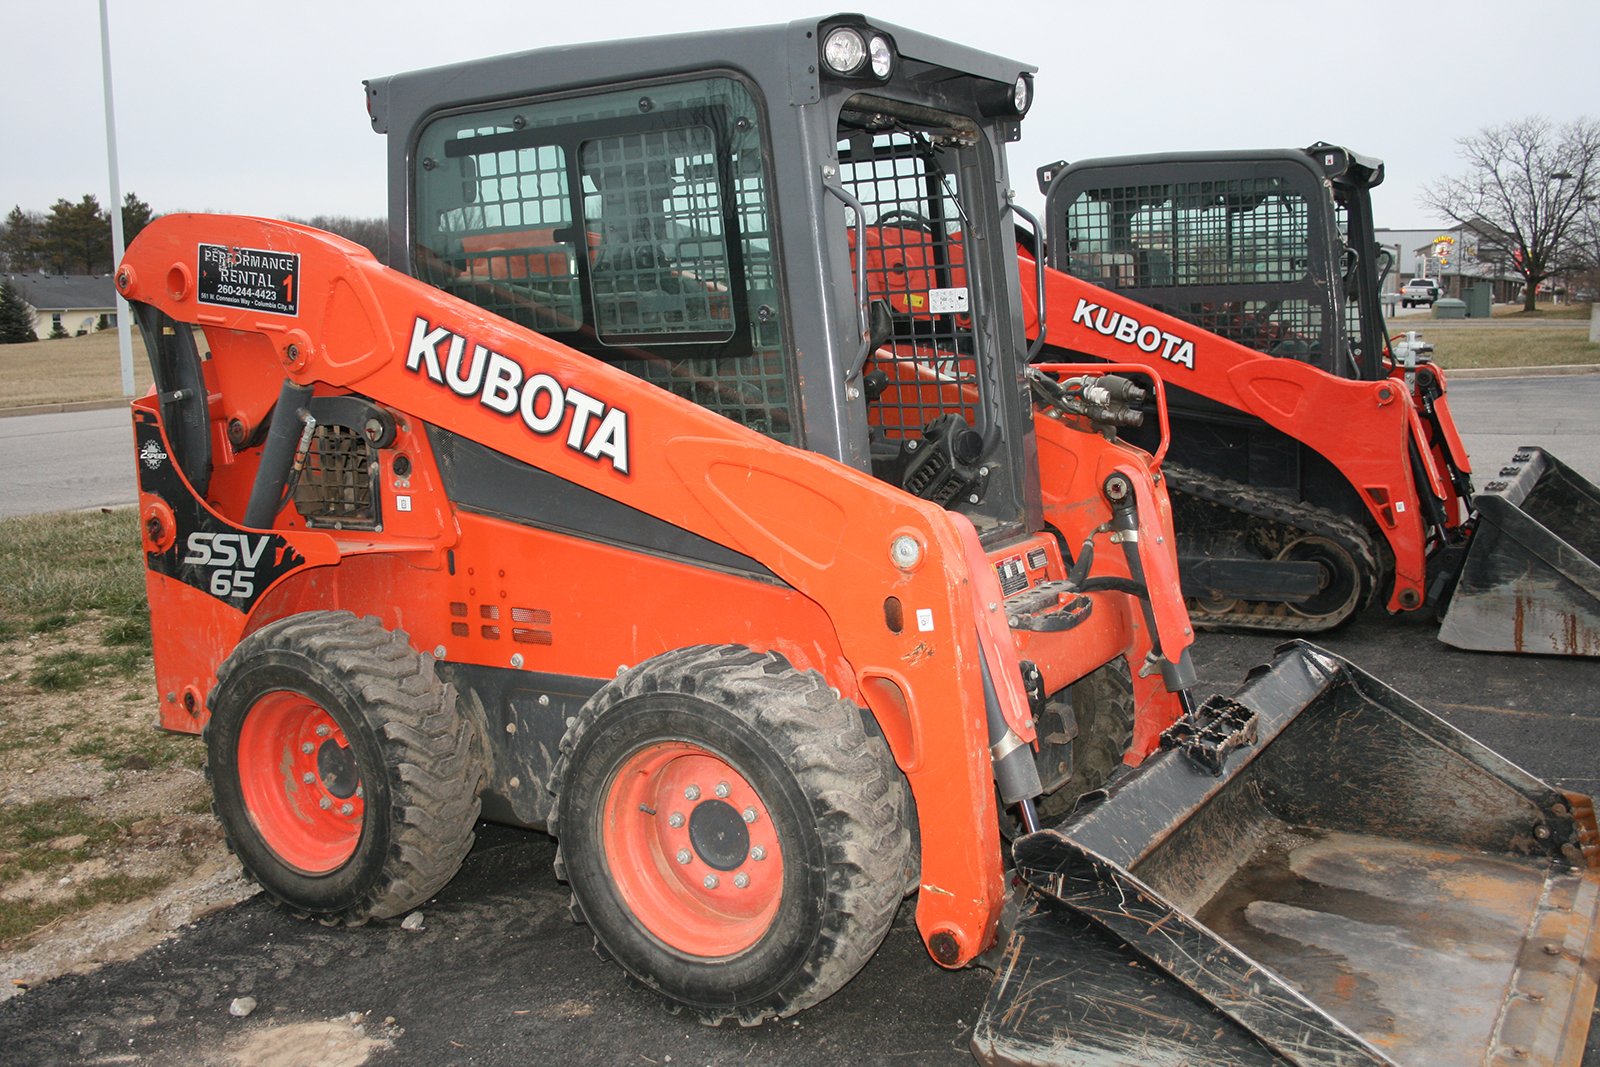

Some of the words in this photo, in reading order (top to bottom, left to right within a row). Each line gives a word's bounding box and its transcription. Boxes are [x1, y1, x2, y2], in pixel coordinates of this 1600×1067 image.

[204, 249, 293, 272] PERFORMANCE
[217, 284, 277, 301] 260-244-4423
[220, 269, 275, 288] RENTAL
[283, 274, 293, 302] 1
[216, 294, 240, 304] Connexion
[240, 297, 251, 306] Way
[254, 300, 276, 309] Columbia
[1072, 298, 1195, 369] KUBOTA
[406, 317, 629, 475] KUBOTA
[184, 532, 270, 568] SSV
[210, 569, 255, 598] 65
